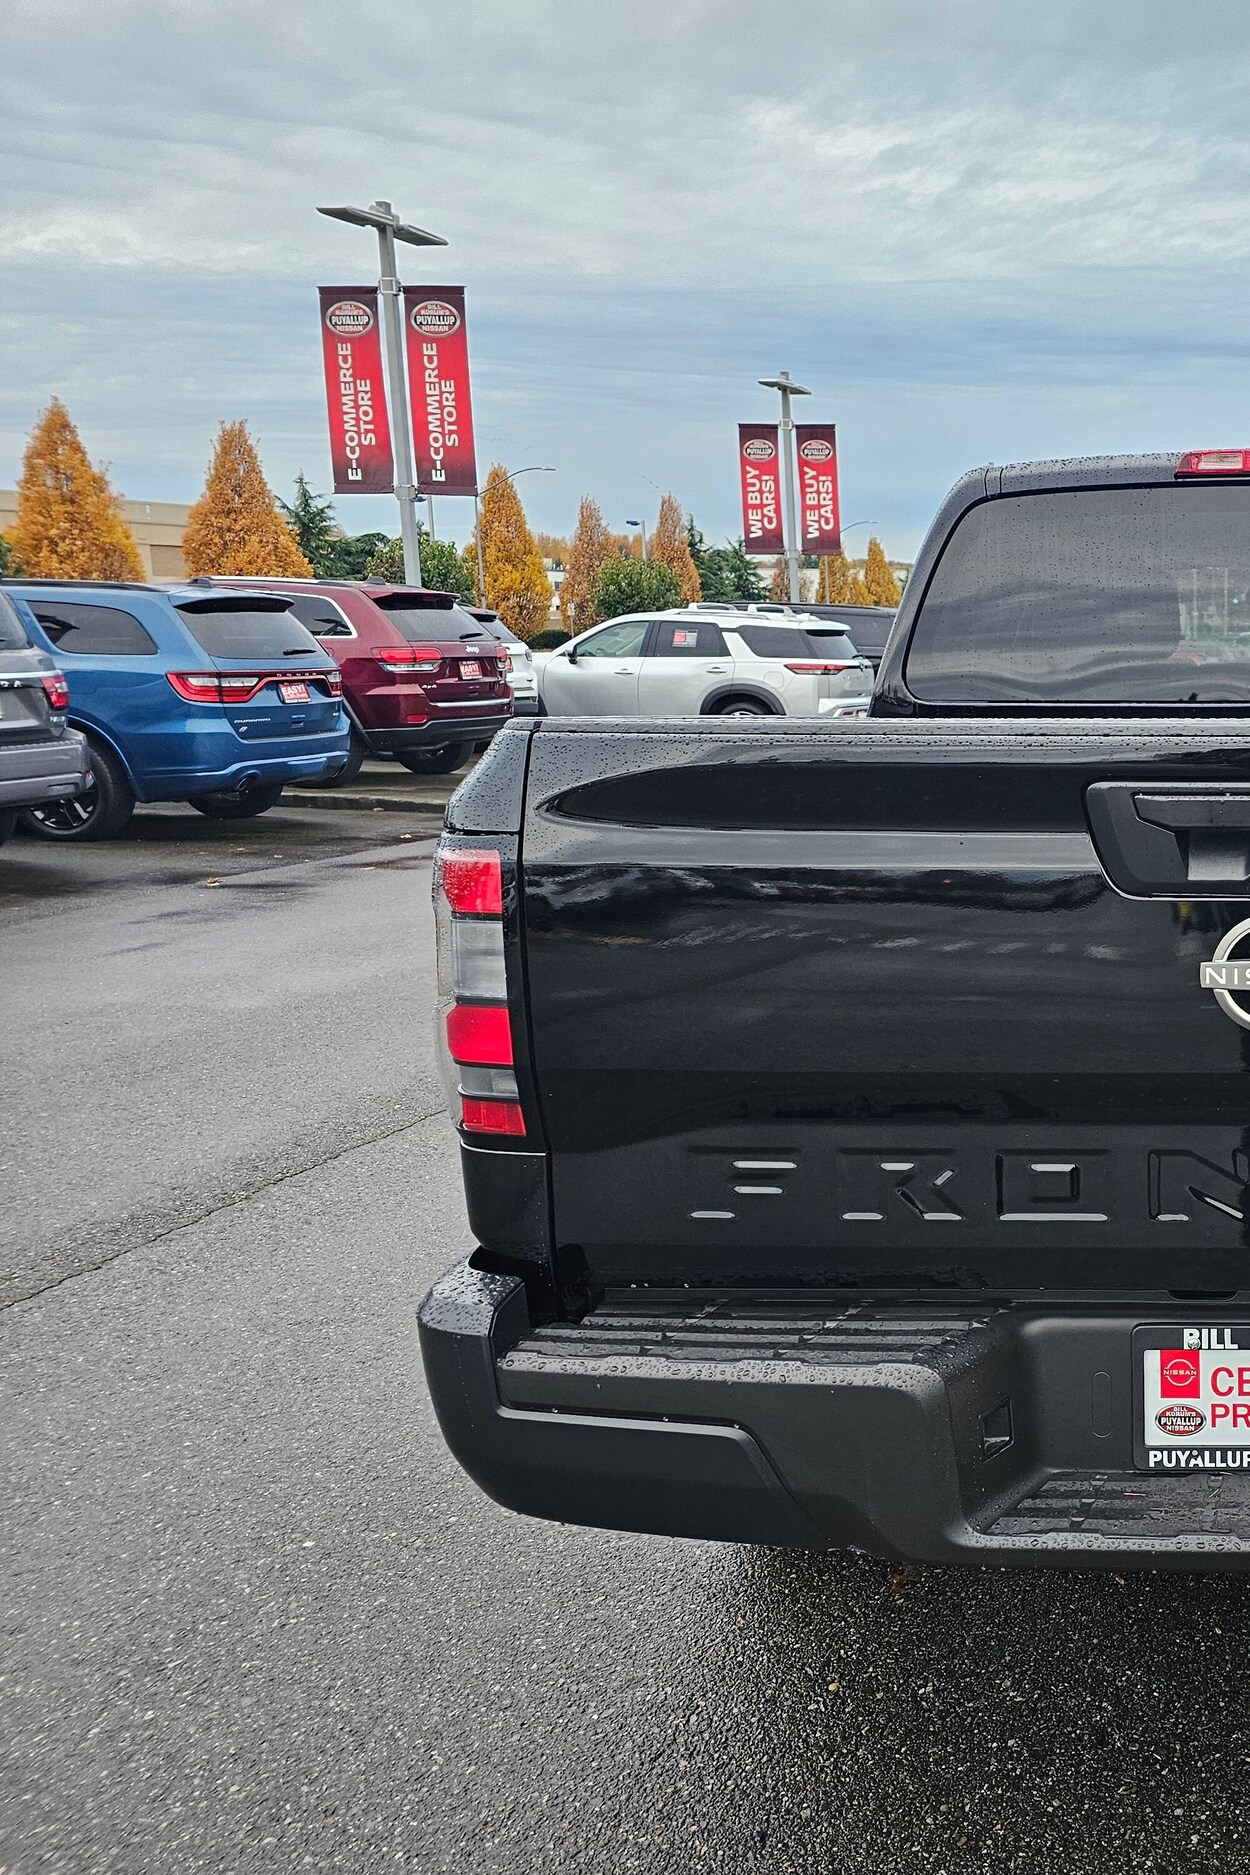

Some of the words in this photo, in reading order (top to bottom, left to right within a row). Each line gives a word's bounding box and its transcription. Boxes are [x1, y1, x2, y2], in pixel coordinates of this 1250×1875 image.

[331, 315, 369, 325] PUYALLUP
[416, 315, 455, 325] PUYALLUP
[337, 342, 362, 480] E-COMMERCE
[356, 379, 376, 446] STORE
[422, 342, 446, 482] E-COMMERCE
[441, 379, 459, 447] STORE
[745, 465, 762, 504] BUY
[803, 466, 819, 505] BUY
[761, 475, 777, 530] CARS!
[818, 476, 835, 530] CARS!
[748, 509, 763, 538] WE
[806, 509, 820, 539] WE
[282, 683, 307, 695] EASY!
[1183, 1328, 1239, 1350] BILL
[1163, 1368, 1197, 1376] NISSAN
[1160, 1417, 1202, 1426] PUYALLUP
